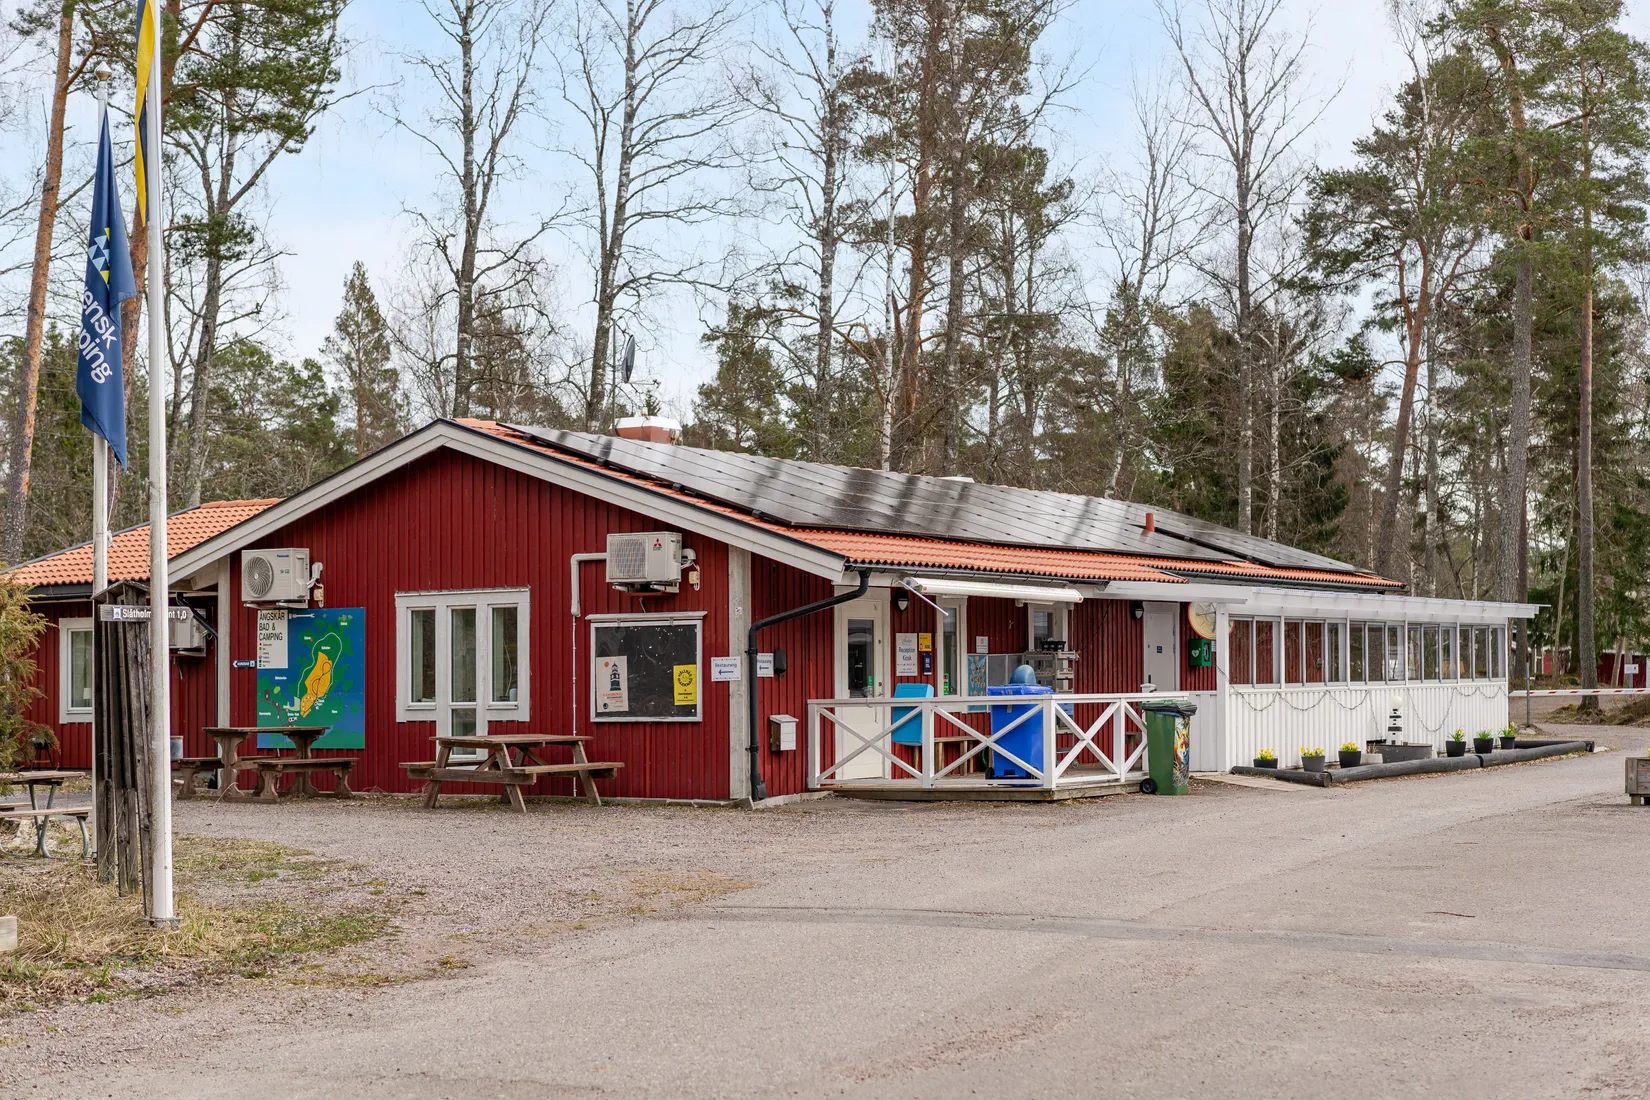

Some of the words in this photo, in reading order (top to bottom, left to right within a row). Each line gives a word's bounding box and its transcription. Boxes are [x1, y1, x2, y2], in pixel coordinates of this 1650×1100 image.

[83, 286, 118, 350] ensk
[79, 322, 113, 384] ping
[176, 610, 187, 620] 1,0
[258, 622, 270, 631] BAD
[271, 622, 276, 631] &
[258, 632, 283, 641] CAMPING
